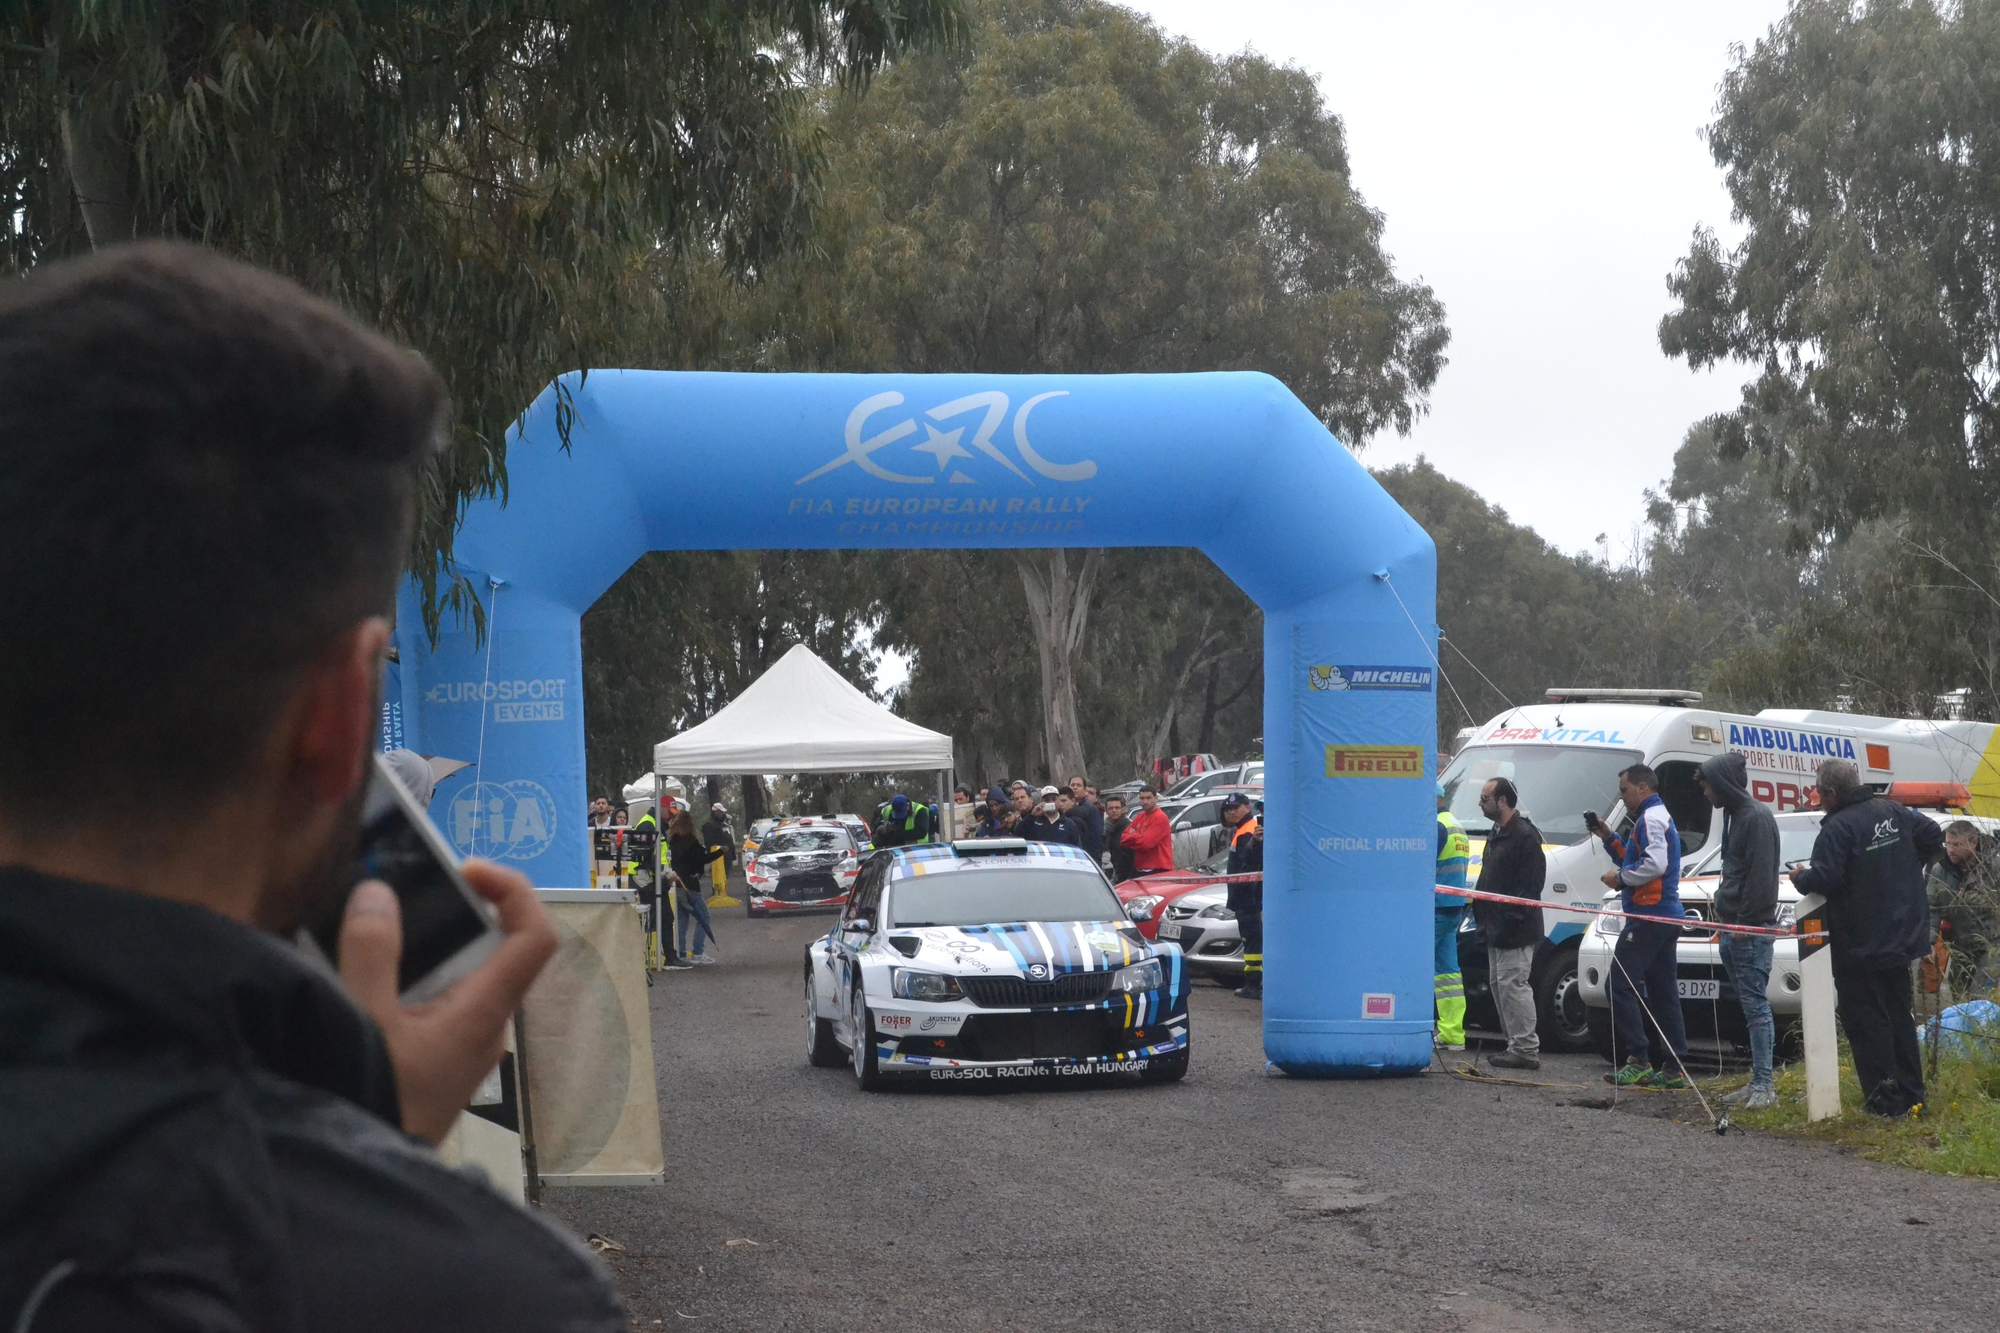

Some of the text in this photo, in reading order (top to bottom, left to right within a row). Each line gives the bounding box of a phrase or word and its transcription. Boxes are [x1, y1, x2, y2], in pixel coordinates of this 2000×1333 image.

[788, 496, 1092, 516] FIA EUROPEAN RALLY
[837, 519, 1086, 535] CHAMPIONSHIP
[1352, 669, 1431, 685] MICHELIN
[424, 679, 566, 702] EUROSPORT
[499, 703, 562, 720] EVENTS
[1729, 724, 1857, 760] AMBULANCIA
[1334, 751, 1418, 772] PIRELLI
[1778, 754, 1807, 772] VITAL
[1318, 837, 1427, 851] OFFICIAL PARTNERS
[1690, 982, 1717, 997] DXP
[997, 1065, 1050, 1078] RACING
[1053, 1063, 1093, 1076] TEAM
[1096, 1059, 1149, 1073] HUNGARY
